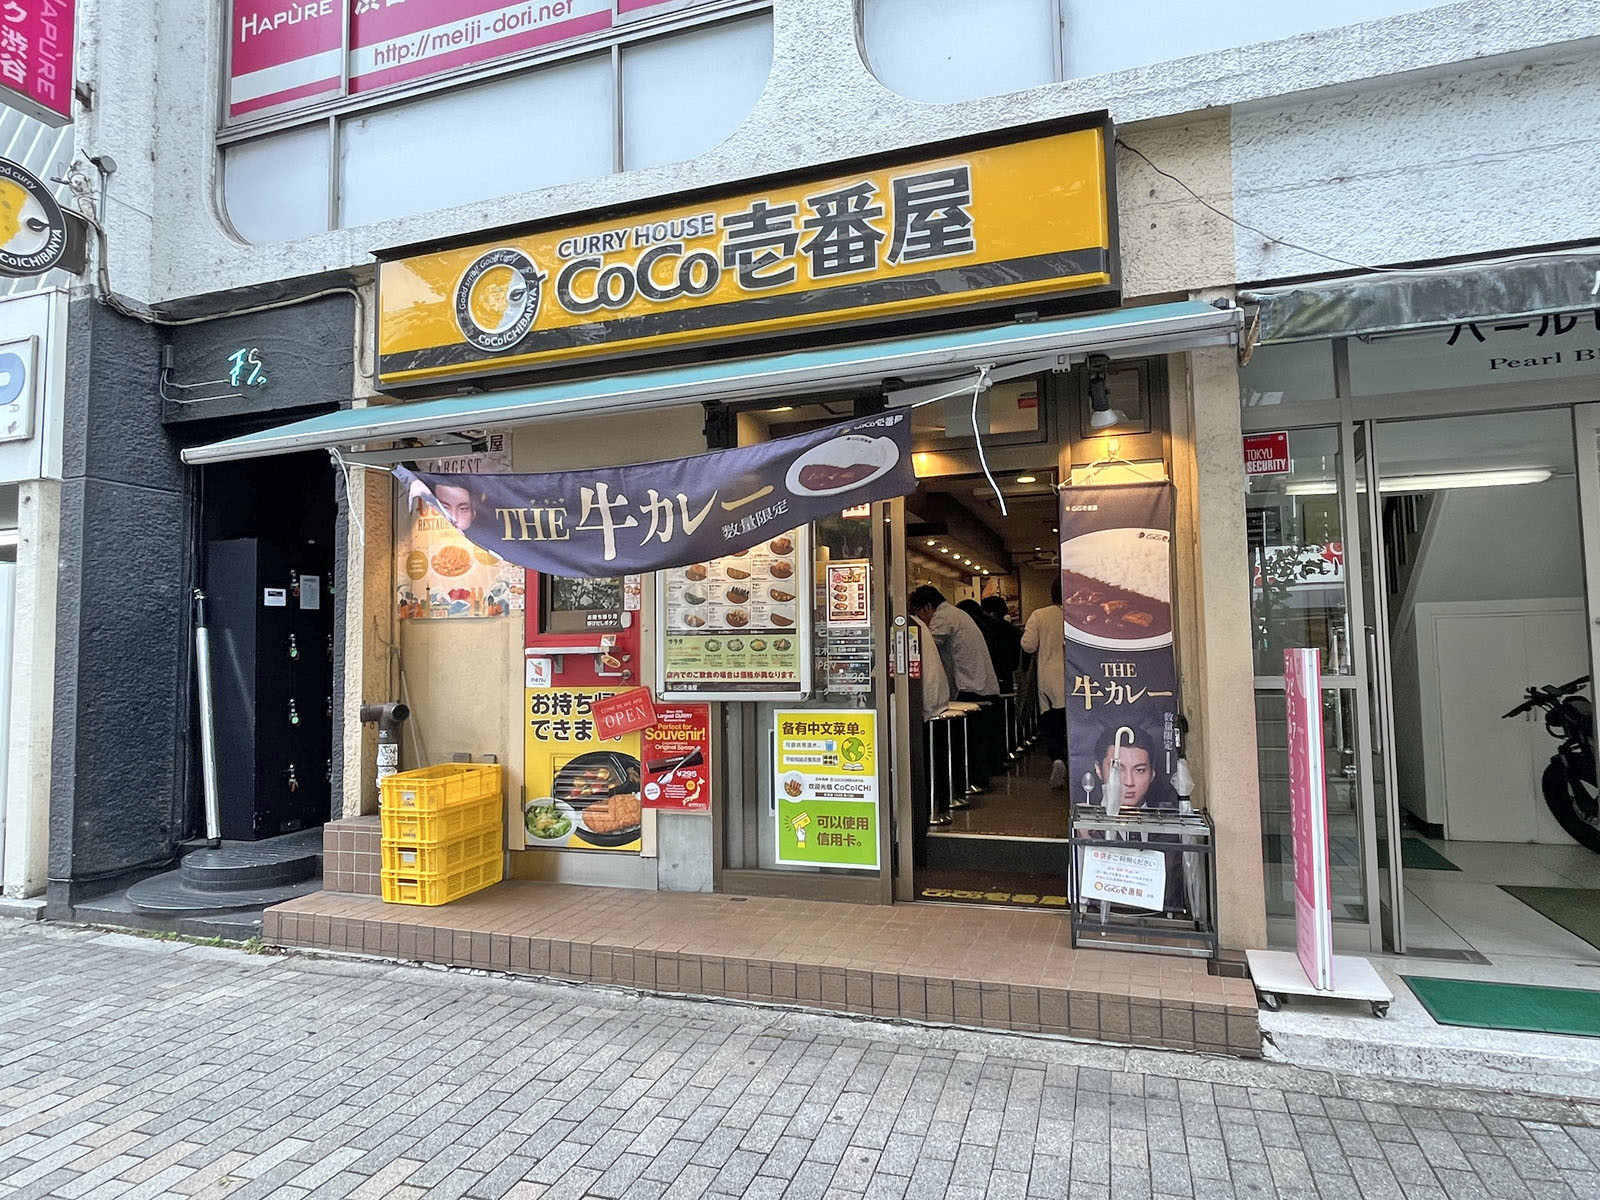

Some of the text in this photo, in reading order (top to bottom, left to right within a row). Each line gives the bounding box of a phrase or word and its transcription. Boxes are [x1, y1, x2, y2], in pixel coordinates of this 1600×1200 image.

[37, 0, 67, 100] APÙRE
[12, 171, 37, 190] curry
[558, 216, 714, 257] CURRY HOUSE
[478, 287, 537, 346] CoCoICHIBANYA
[1489, 347, 1600, 371] Pearl B
[1246, 447, 1273, 461] TOKYU
[1247, 458, 1286, 473] SECURITY
[495, 482, 775, 561] THE 牛カレー
[721, 498, 789, 541] 数量限定
[1100, 662, 1138, 678] THE
[1071, 675, 1173, 710] 牛カレー
[605, 704, 646, 729] OPEN
[644, 727, 706, 741] Souvenir!
[782, 721, 866, 736] 备有中文菜单。
[834, 784, 872, 792] CoCoICHI
[816, 815, 869, 831] 可以使用
[816, 832, 862, 847] 信用卡。
